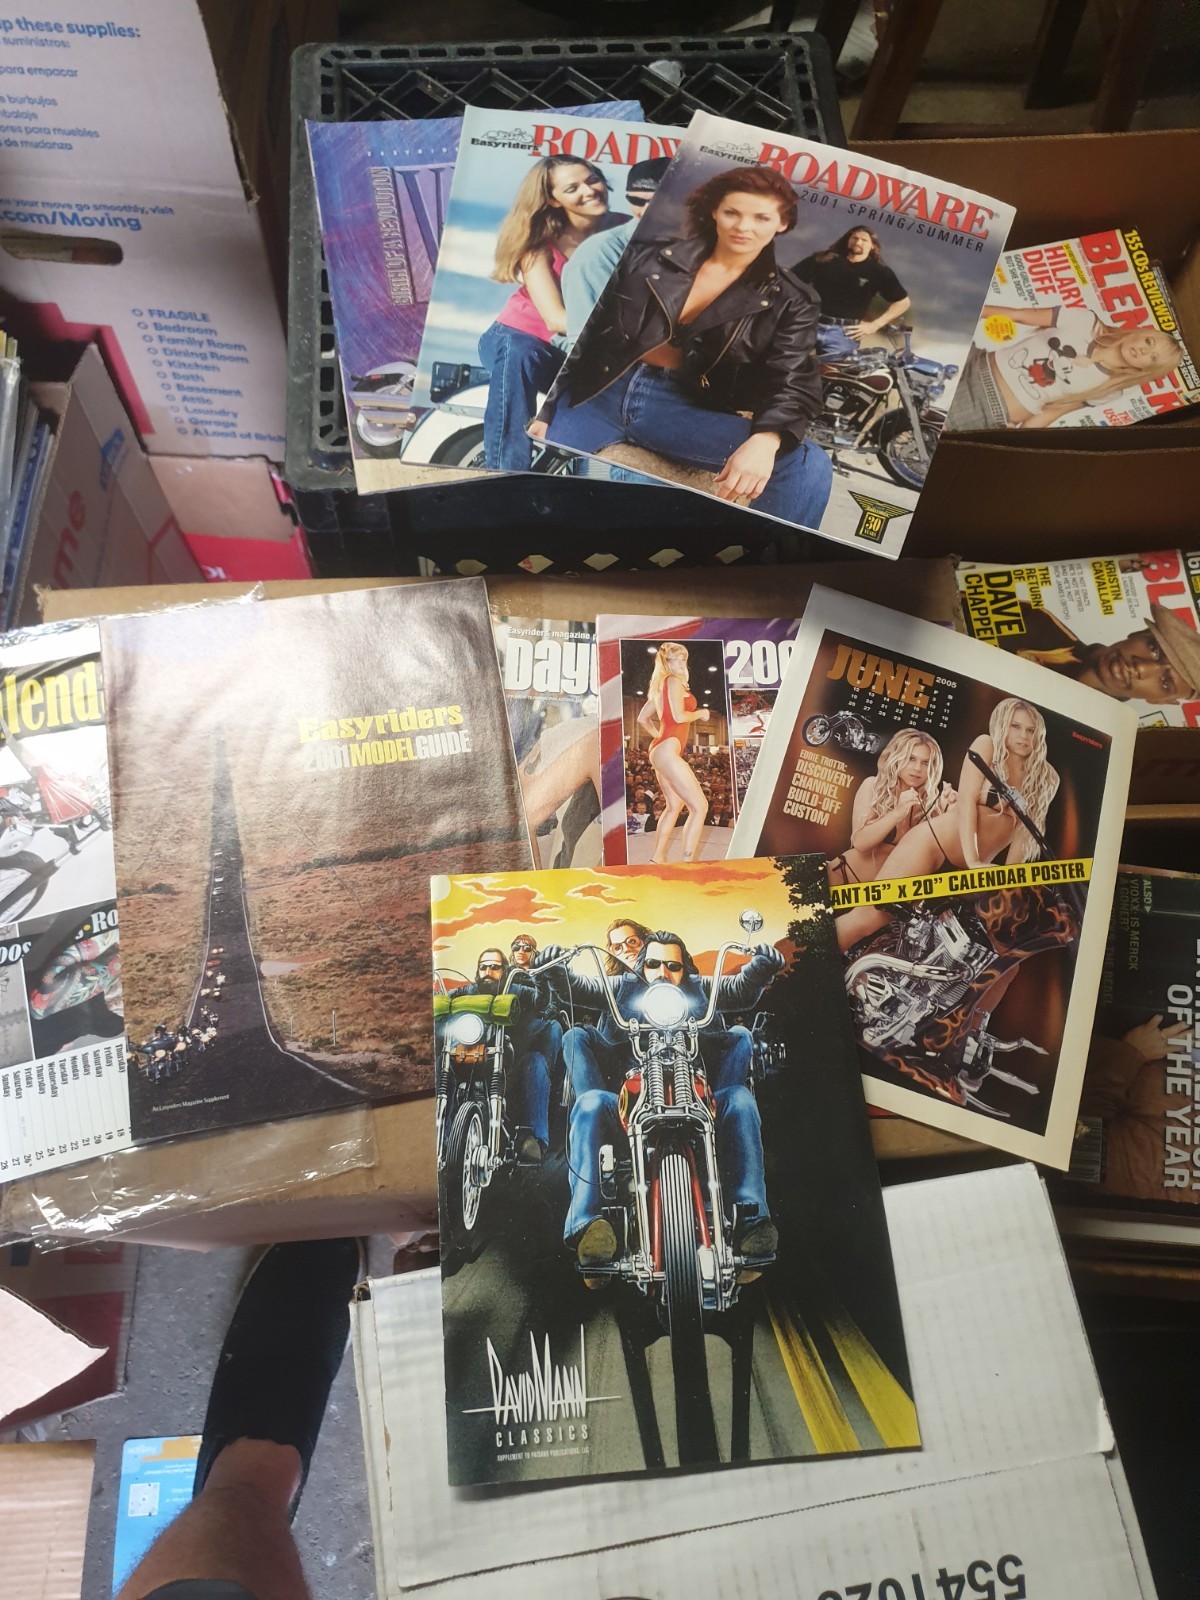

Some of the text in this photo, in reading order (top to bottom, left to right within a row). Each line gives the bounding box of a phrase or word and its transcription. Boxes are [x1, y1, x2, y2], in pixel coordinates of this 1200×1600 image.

[0, 16, 141, 38] p these supplies:
[26, 66, 78, 77] empacar
[6, 94, 58, 108] burbujas
[471, 137, 539, 151] Easyriders
[757, 141, 994, 240] ROADWARE
[800, 189, 985, 253] 2001 SPRING/SUMMER
[1124, 229, 1144, 251] 155
[1022, 249, 1058, 296] DUFF
[1132, 250, 1150, 272] CDs
[1043, 245, 1088, 309] HILARY
[148, 308, 211, 323] FRAGILE
[1139, 270, 1177, 332] REVIEWED
[153, 321, 218, 337] Bedroom
[158, 334, 248, 352] Family Room
[162, 346, 250, 364] Dining Room
[167, 358, 221, 373] Kitchen
[865, 515, 882, 532] 30
[1013, 569, 1026, 582] OF
[1025, 567, 1044, 608] RETURN
[1038, 565, 1052, 586] THE
[1091, 561, 1115, 616] CAVALLARI
[1104, 560, 1123, 601] KRISTIN
[984, 570, 1025, 635] DAVE
[508, 626, 591, 640] Easyriders magazine
[826, 643, 957, 709] JUNE 2005
[0, 661, 105, 738] lend
[298, 704, 464, 744] Easyriders
[795, 758, 854, 788] DISCOVERY
[799, 749, 848, 772] EDDIE TROTTA:
[786, 785, 842, 814] BUILD-OFF
[791, 772, 839, 799] CHANNEL
[783, 799, 830, 826] CUSTOM
[948, 864, 1027, 892] CALENDAR
[1031, 861, 1086, 883] POSTER
[1142, 878, 1153, 906] ALSO
[1128, 930, 1140, 971] MERCK
[115, 1043, 126, 1073] Thursday
[13, 1070, 23, 1100] Saturday
[81, 1052, 102, 1145] Sunday 20
[92, 1049, 114, 1140] Saturday 19
[104, 1046, 126, 1137] Friday 18
[1163, 984, 1194, 1189] OF THE YEAR
[24, 1067, 45, 1160] Friday 25
[36, 1063, 56, 1157] Thursday 24
[47, 1061, 68, 1154] Wednesday 23
[59, 1058, 80, 1151] Tuesday 22
[69, 1055, 91, 1147] Monday 21
[2, 1073, 21, 1167] Sunday 27
[495, 1424, 589, 1448] CLASSICS
